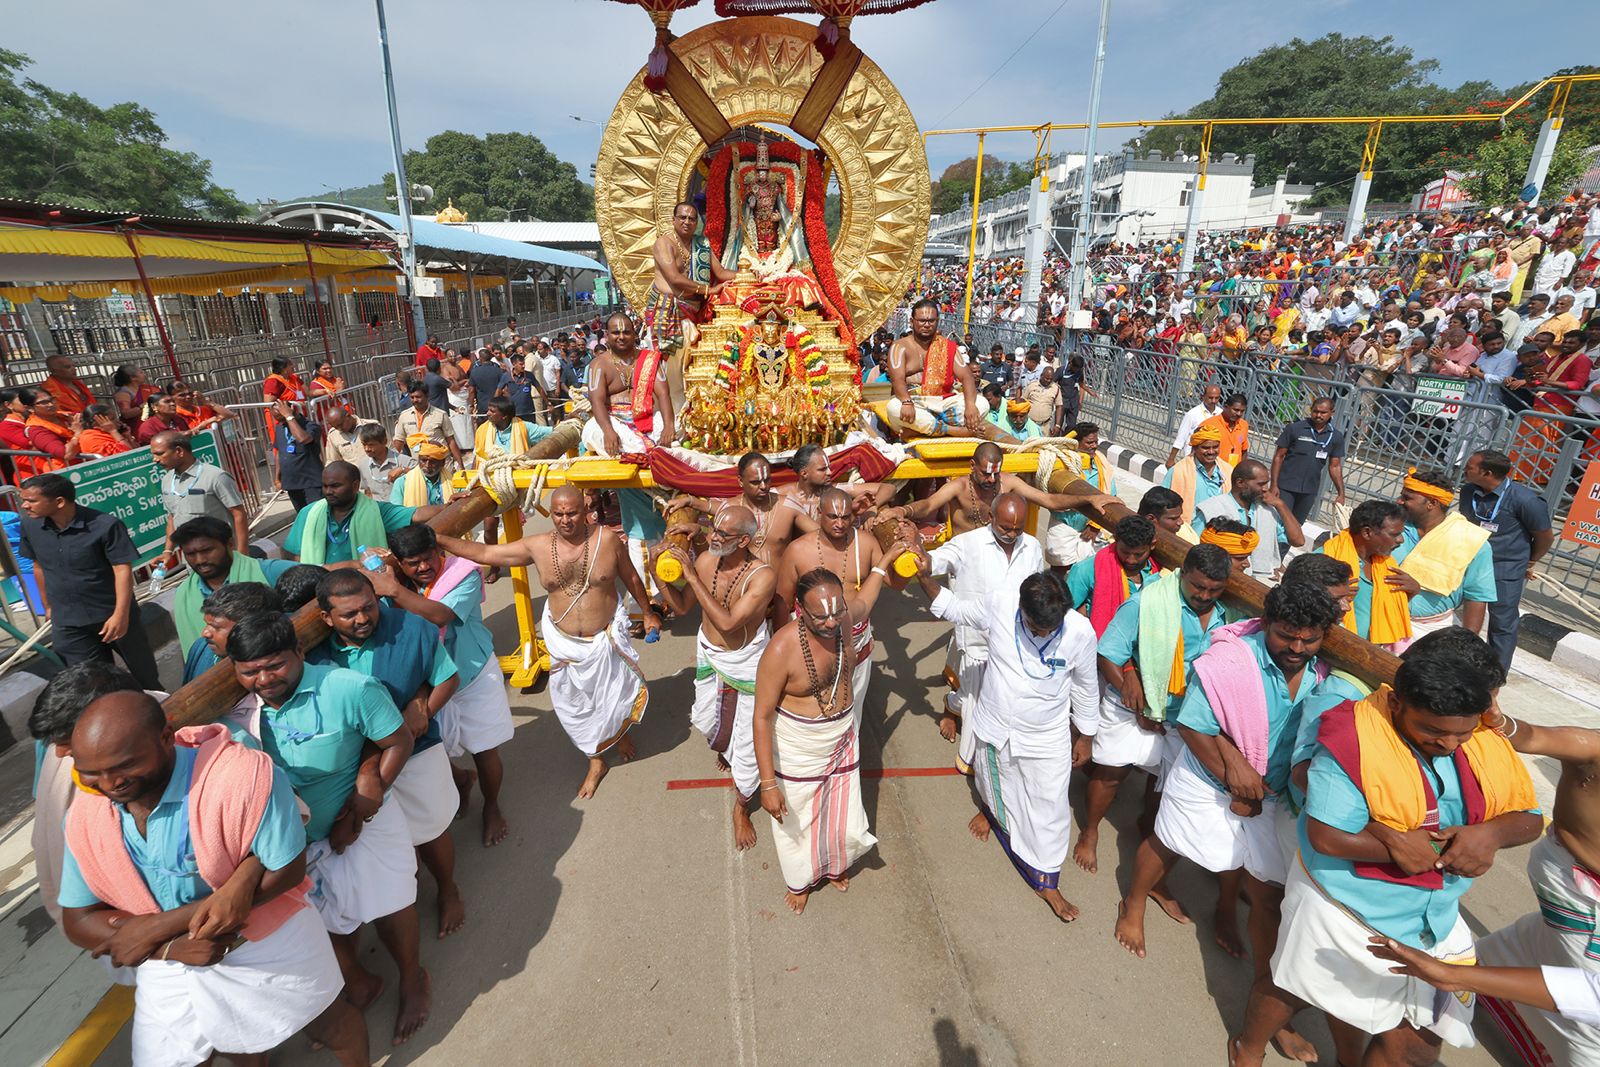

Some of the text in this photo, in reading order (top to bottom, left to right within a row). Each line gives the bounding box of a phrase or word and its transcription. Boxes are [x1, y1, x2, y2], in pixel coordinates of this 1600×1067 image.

[1419, 380, 1465, 391] NORTH MADA
[83, 465, 111, 477] TIRUMALA
[110, 460, 133, 470] TIRUPATI
[74, 476, 147, 507] రాహస్వామి
[138, 493, 164, 511] Swa
